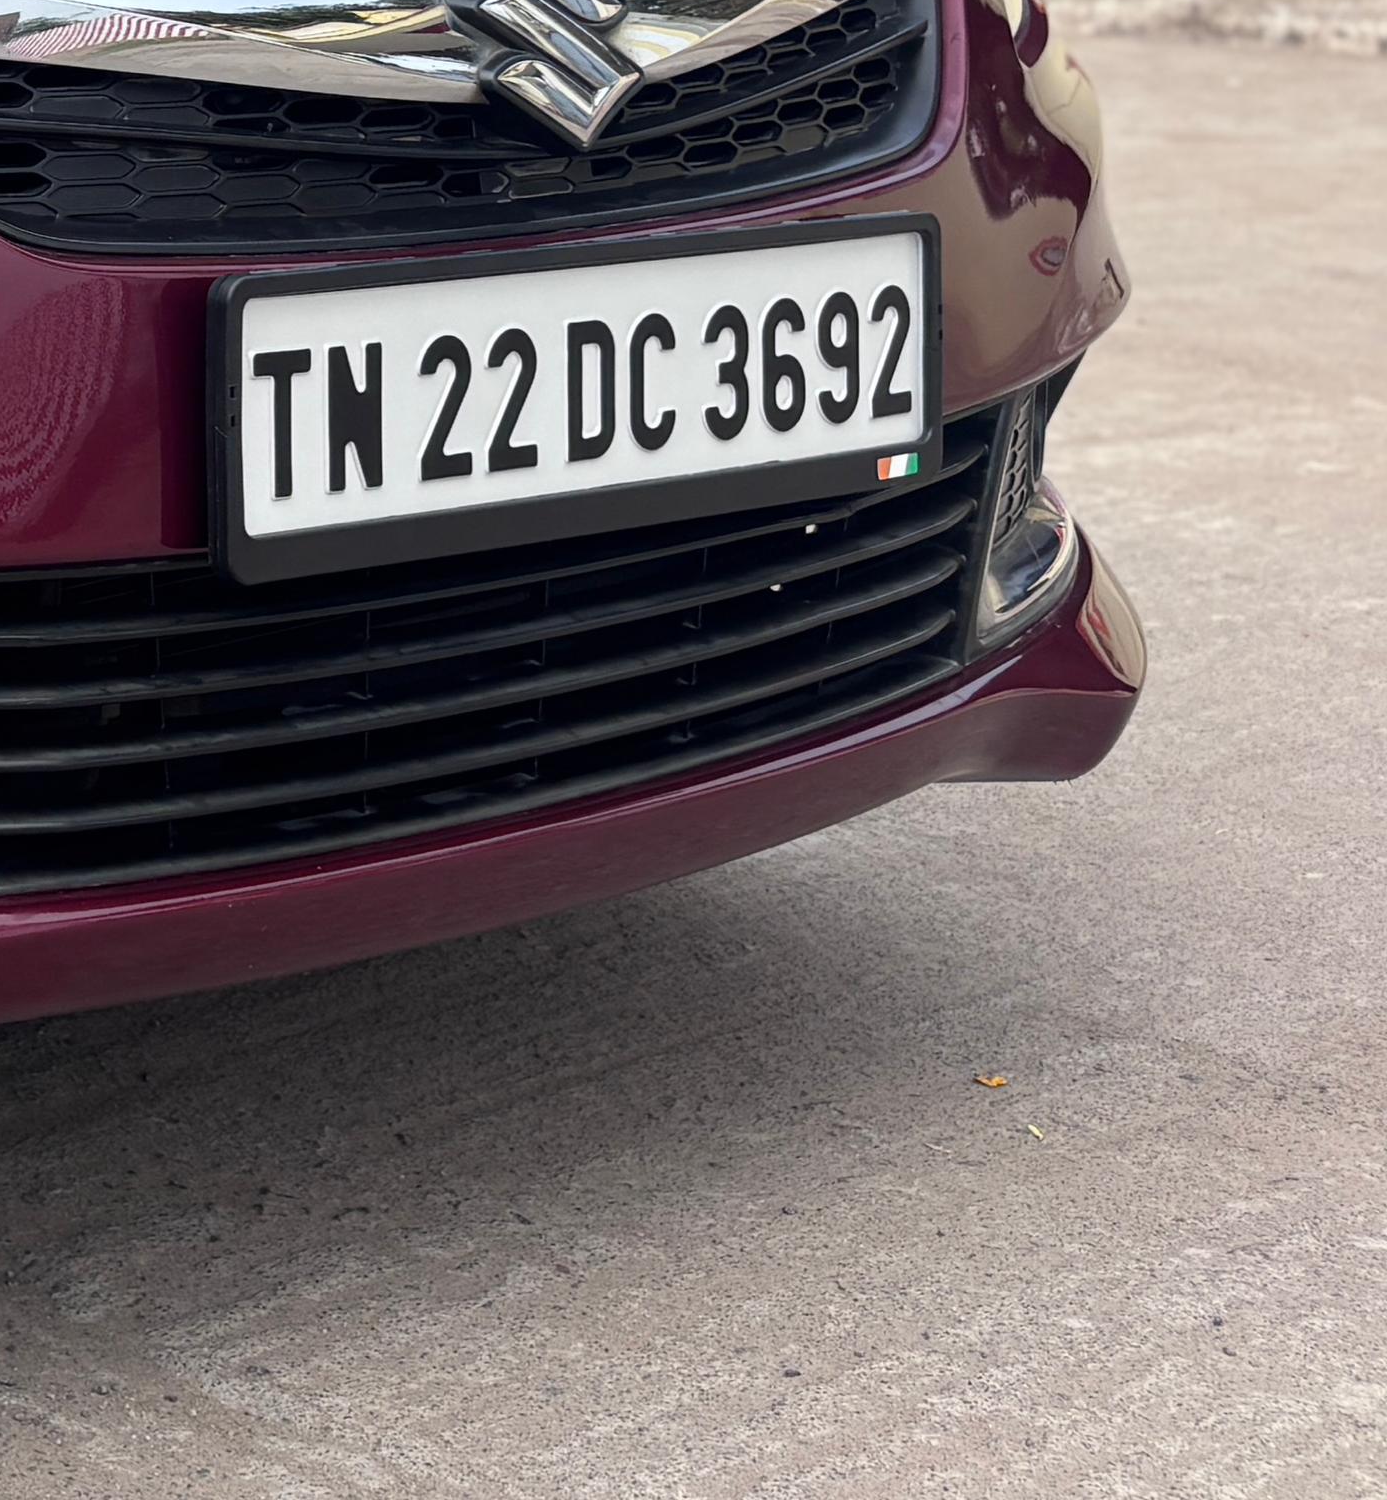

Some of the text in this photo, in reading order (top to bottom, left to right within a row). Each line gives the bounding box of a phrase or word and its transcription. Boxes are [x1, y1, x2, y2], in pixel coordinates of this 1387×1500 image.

[249, 284, 913, 501] TN 22 DC 3692
